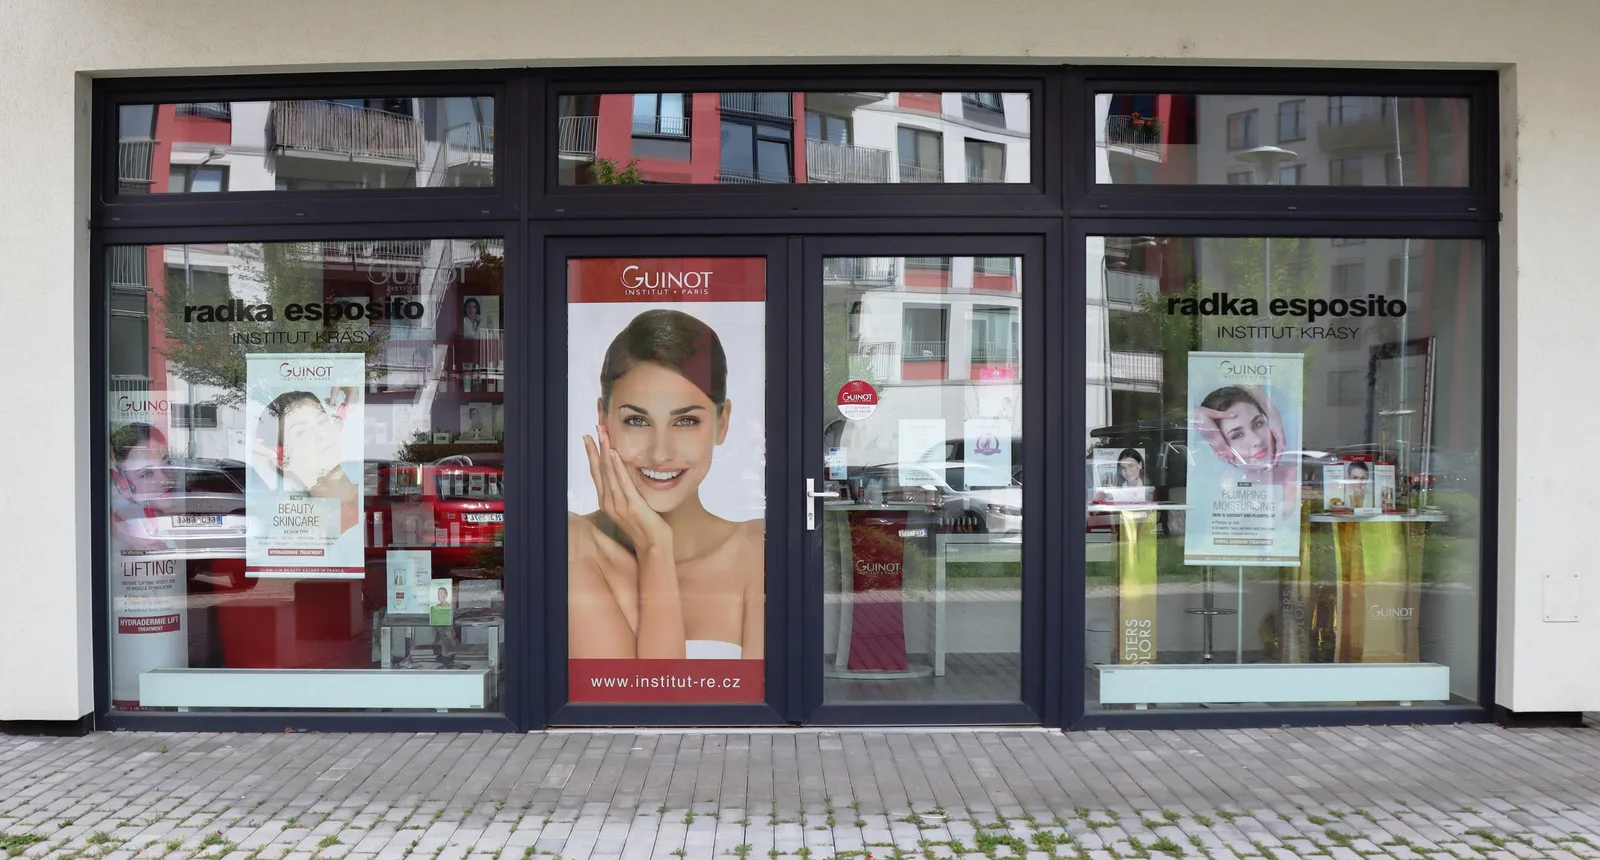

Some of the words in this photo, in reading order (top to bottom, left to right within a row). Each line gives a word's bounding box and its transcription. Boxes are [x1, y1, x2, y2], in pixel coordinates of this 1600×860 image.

[367, 262, 471, 285] GUIOT
[620, 265, 713, 289] GUINOT
[184, 299, 274, 323] radka
[284, 299, 425, 327] esposito
[1167, 293, 1259, 316] radka
[1269, 293, 1407, 322] esposito
[232, 330, 311, 345] INSTITUT
[1217, 326, 1295, 340] INSTITUT
[1301, 323, 1360, 340] KRÁSY
[279, 362, 333, 378] GUINOT
[1220, 360, 1275, 376] GUINOT
[117, 396, 174, 412] GUINOT
[842, 392, 872, 401] GUINOT
[1221, 489, 1267, 500] PLUMPING
[278, 503, 315, 514] BEAUTY
[273, 515, 320, 527] SKINCARE
[855, 560, 901, 572] GUINOT
[1369, 605, 1414, 617] GUINOT
[120, 617, 167, 627] HYDRADERMIE
[167, 615, 179, 624] LIFT
[1125, 619, 1138, 666] STERS
[590, 674, 741, 688] www.institut-re.cz
